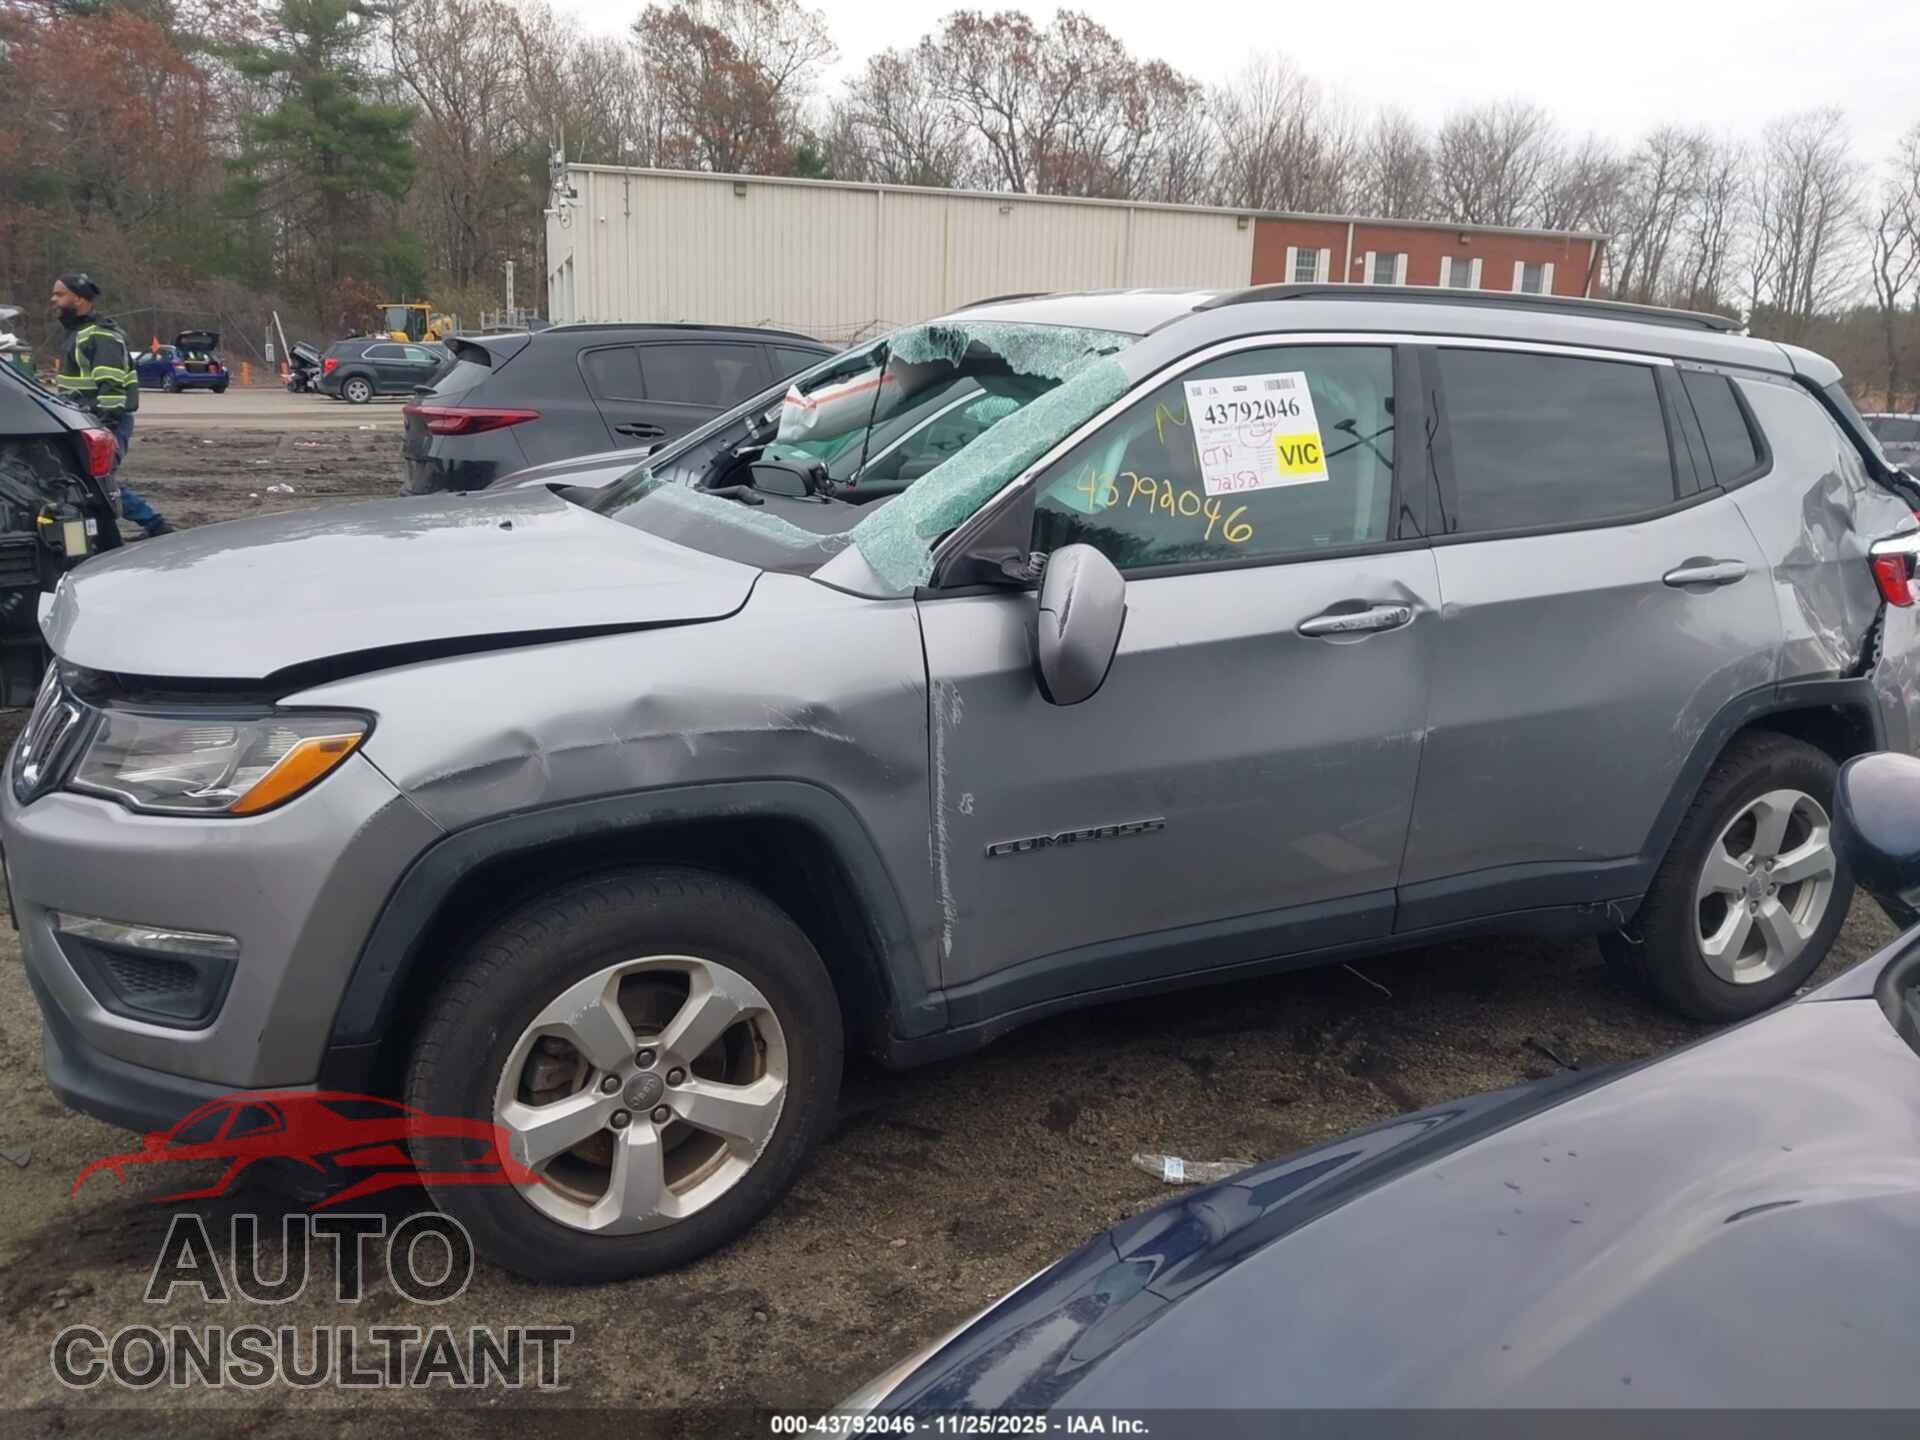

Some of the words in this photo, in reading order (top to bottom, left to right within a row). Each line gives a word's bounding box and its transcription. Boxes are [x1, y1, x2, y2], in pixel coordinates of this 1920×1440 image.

[1204, 397, 1301, 425] 43792046
[1279, 443, 1319, 466] VIC
[985, 816, 1167, 857] COMPASS
